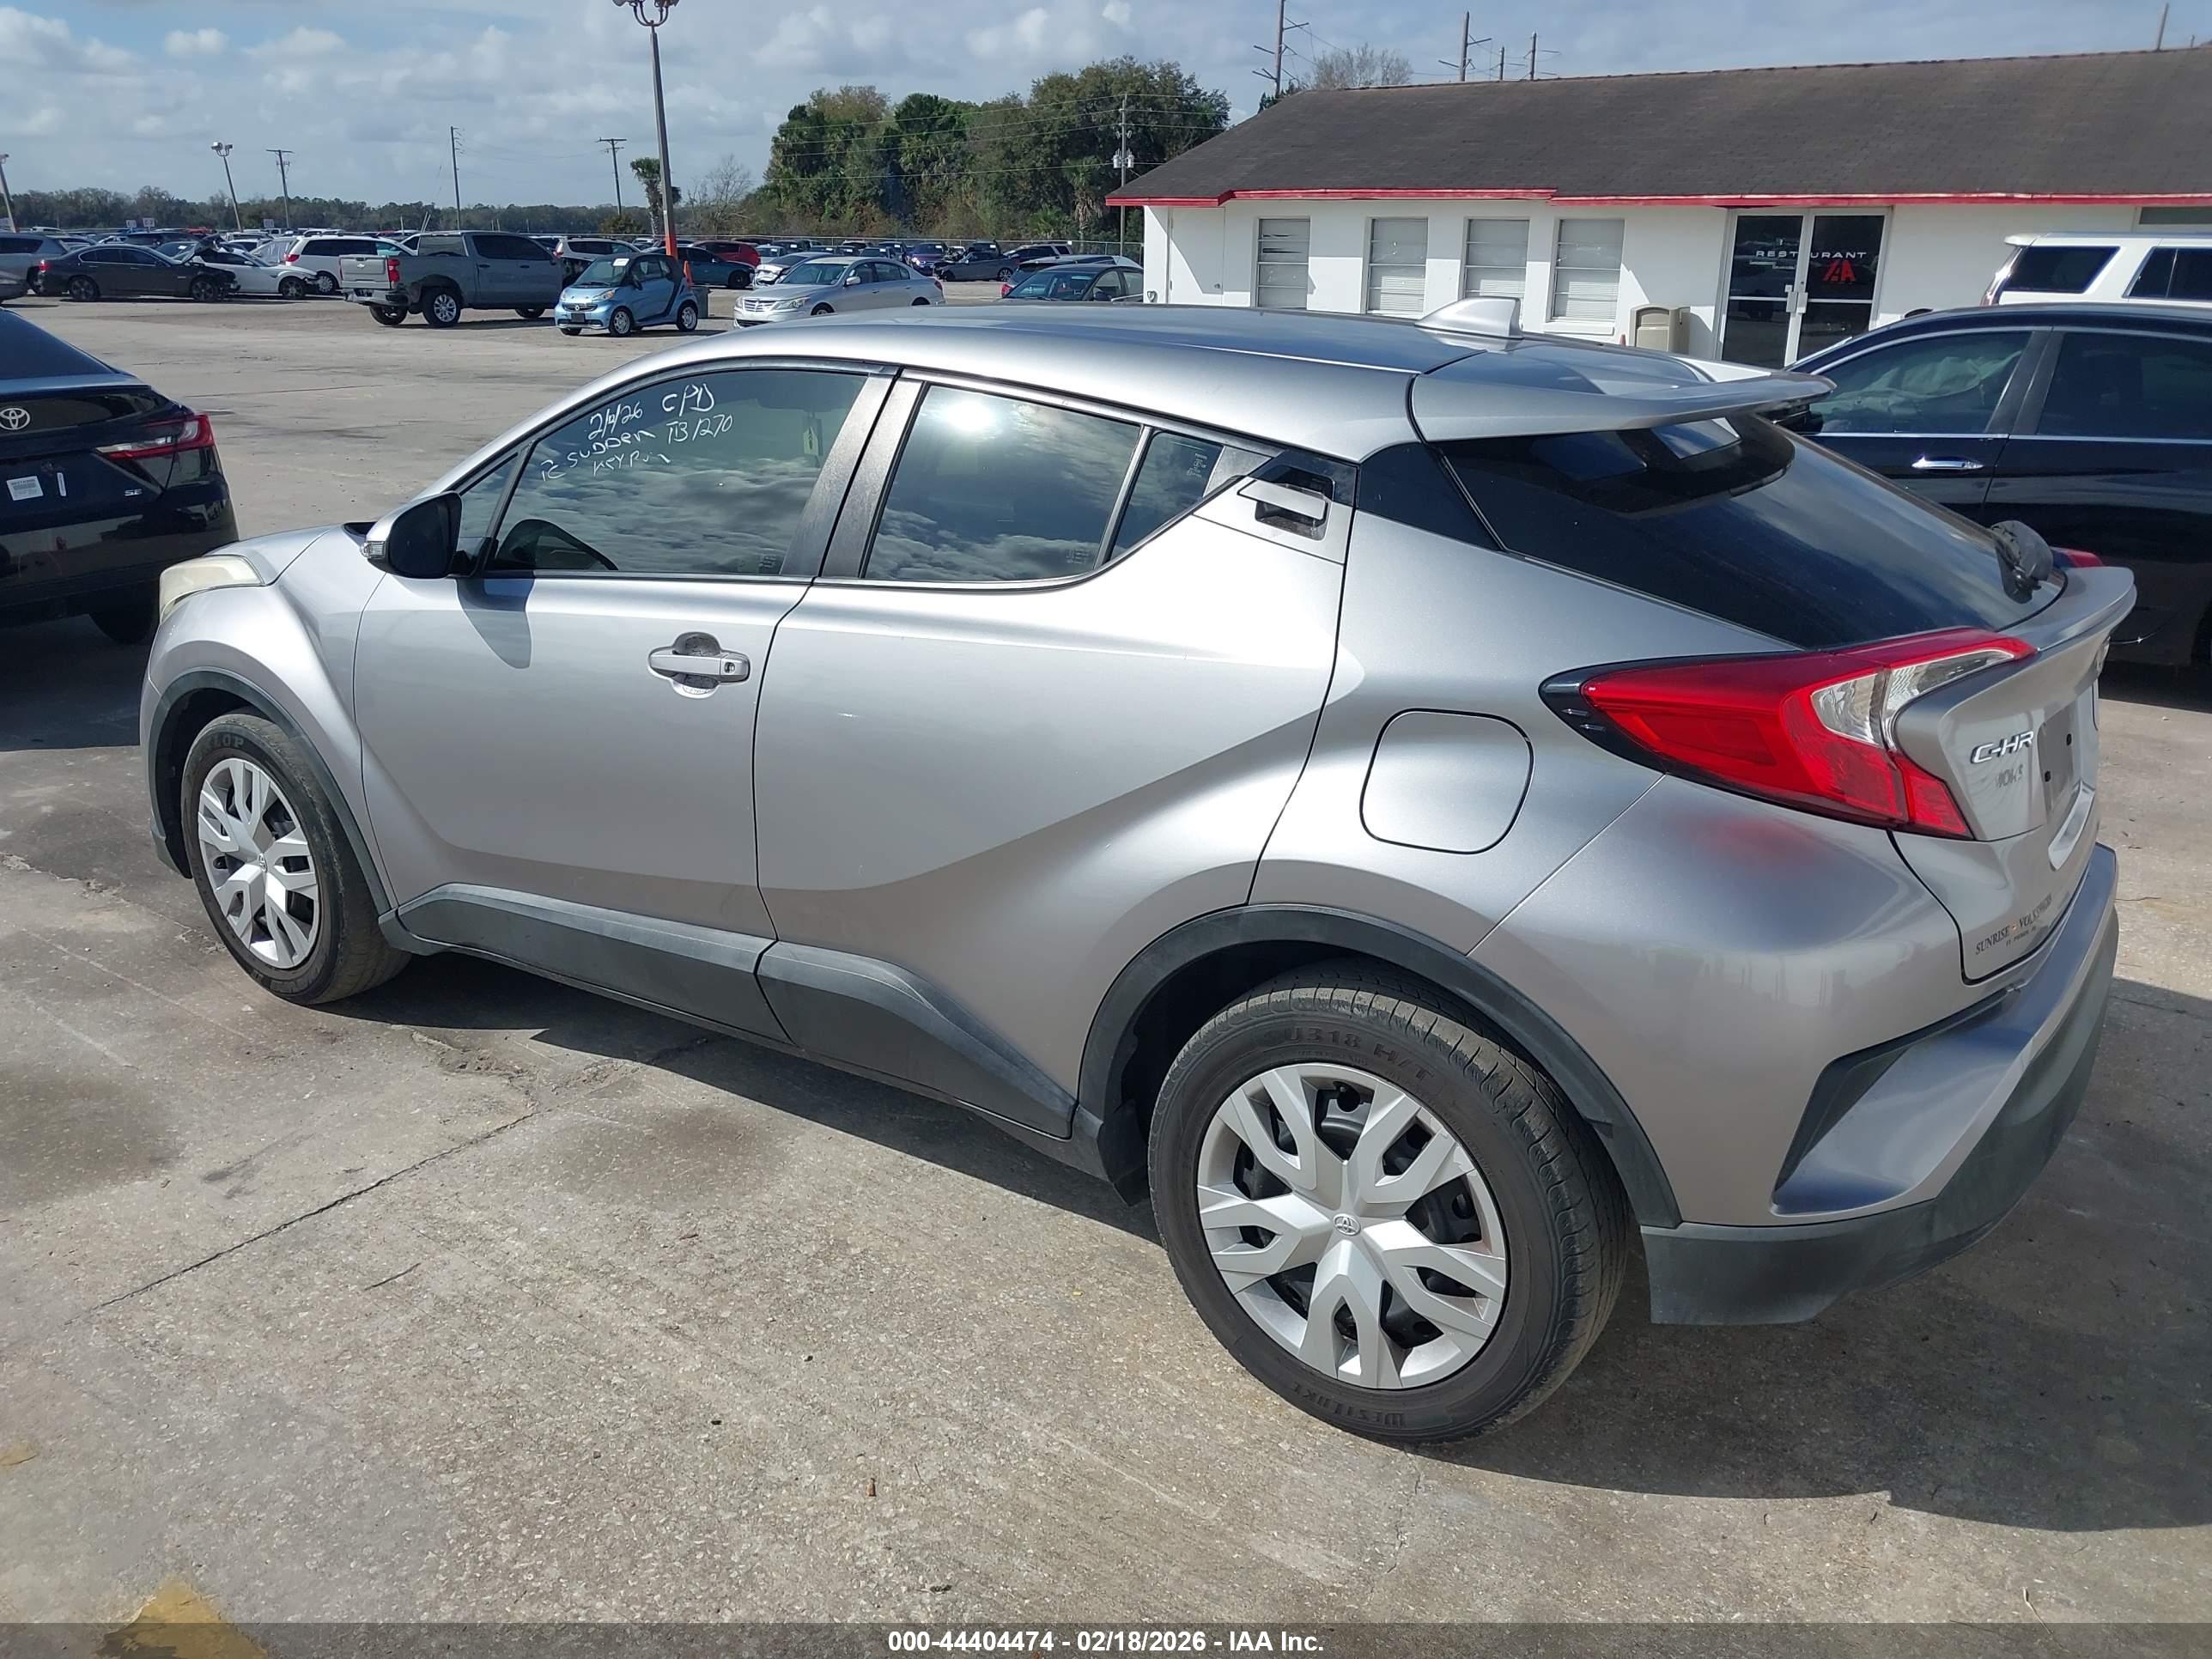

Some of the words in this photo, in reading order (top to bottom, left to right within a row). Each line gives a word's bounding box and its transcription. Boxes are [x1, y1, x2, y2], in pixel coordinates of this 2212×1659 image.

[1755, 250, 1867, 258] RESTURANT
[661, 383, 714, 417] CPD
[1971, 730, 2035, 764] C-HR
[1975, 925, 2011, 956] SUNRISE
